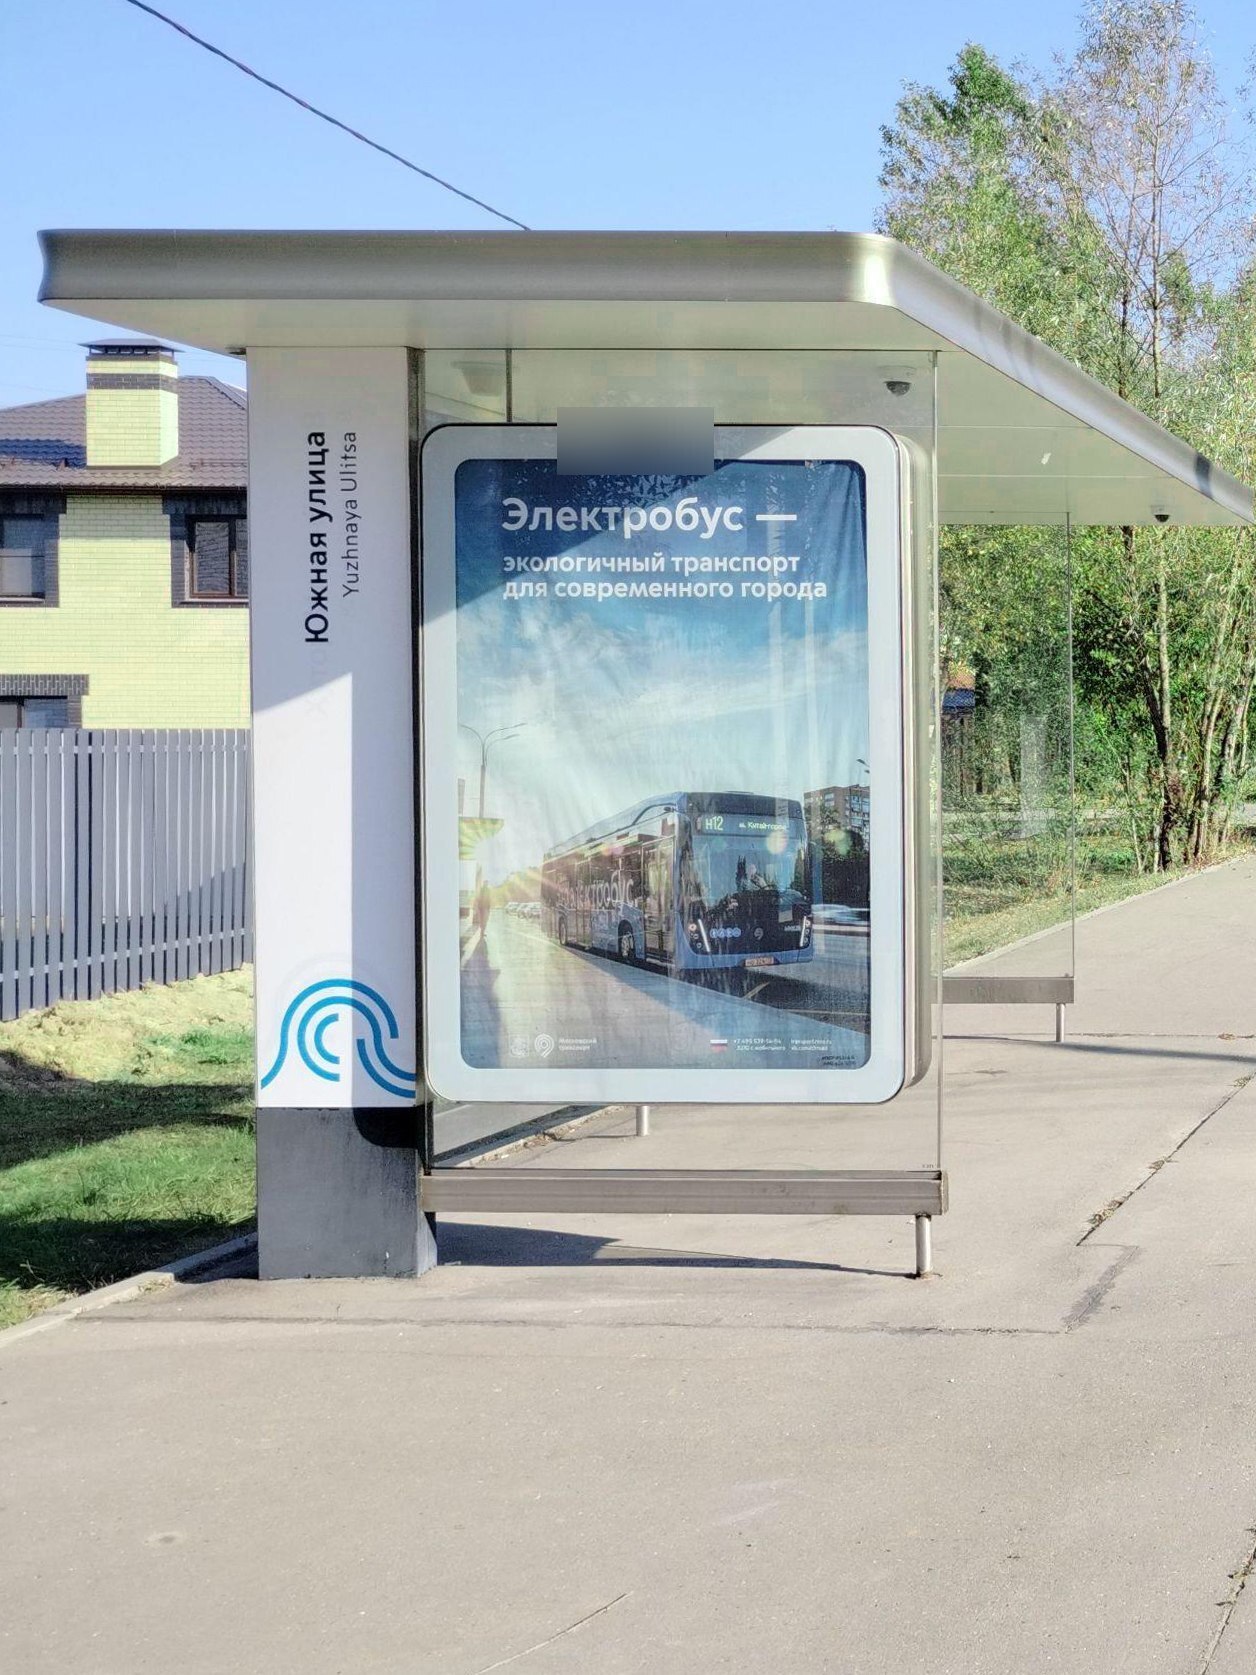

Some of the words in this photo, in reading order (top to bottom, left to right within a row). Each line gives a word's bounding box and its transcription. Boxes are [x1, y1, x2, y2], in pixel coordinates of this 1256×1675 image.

[307, 432, 333, 523] улица
[340, 431, 357, 492] Ulitsa
[341, 499, 362, 598] Yuzhnaya
[501, 497, 744, 539] Электробус
[305, 532, 329, 643] Южная
[503, 552, 665, 573] экологичный
[671, 555, 800, 578] транспорт
[503, 580, 548, 600] для
[555, 581, 734, 603] современного
[741, 581, 828, 602] города
